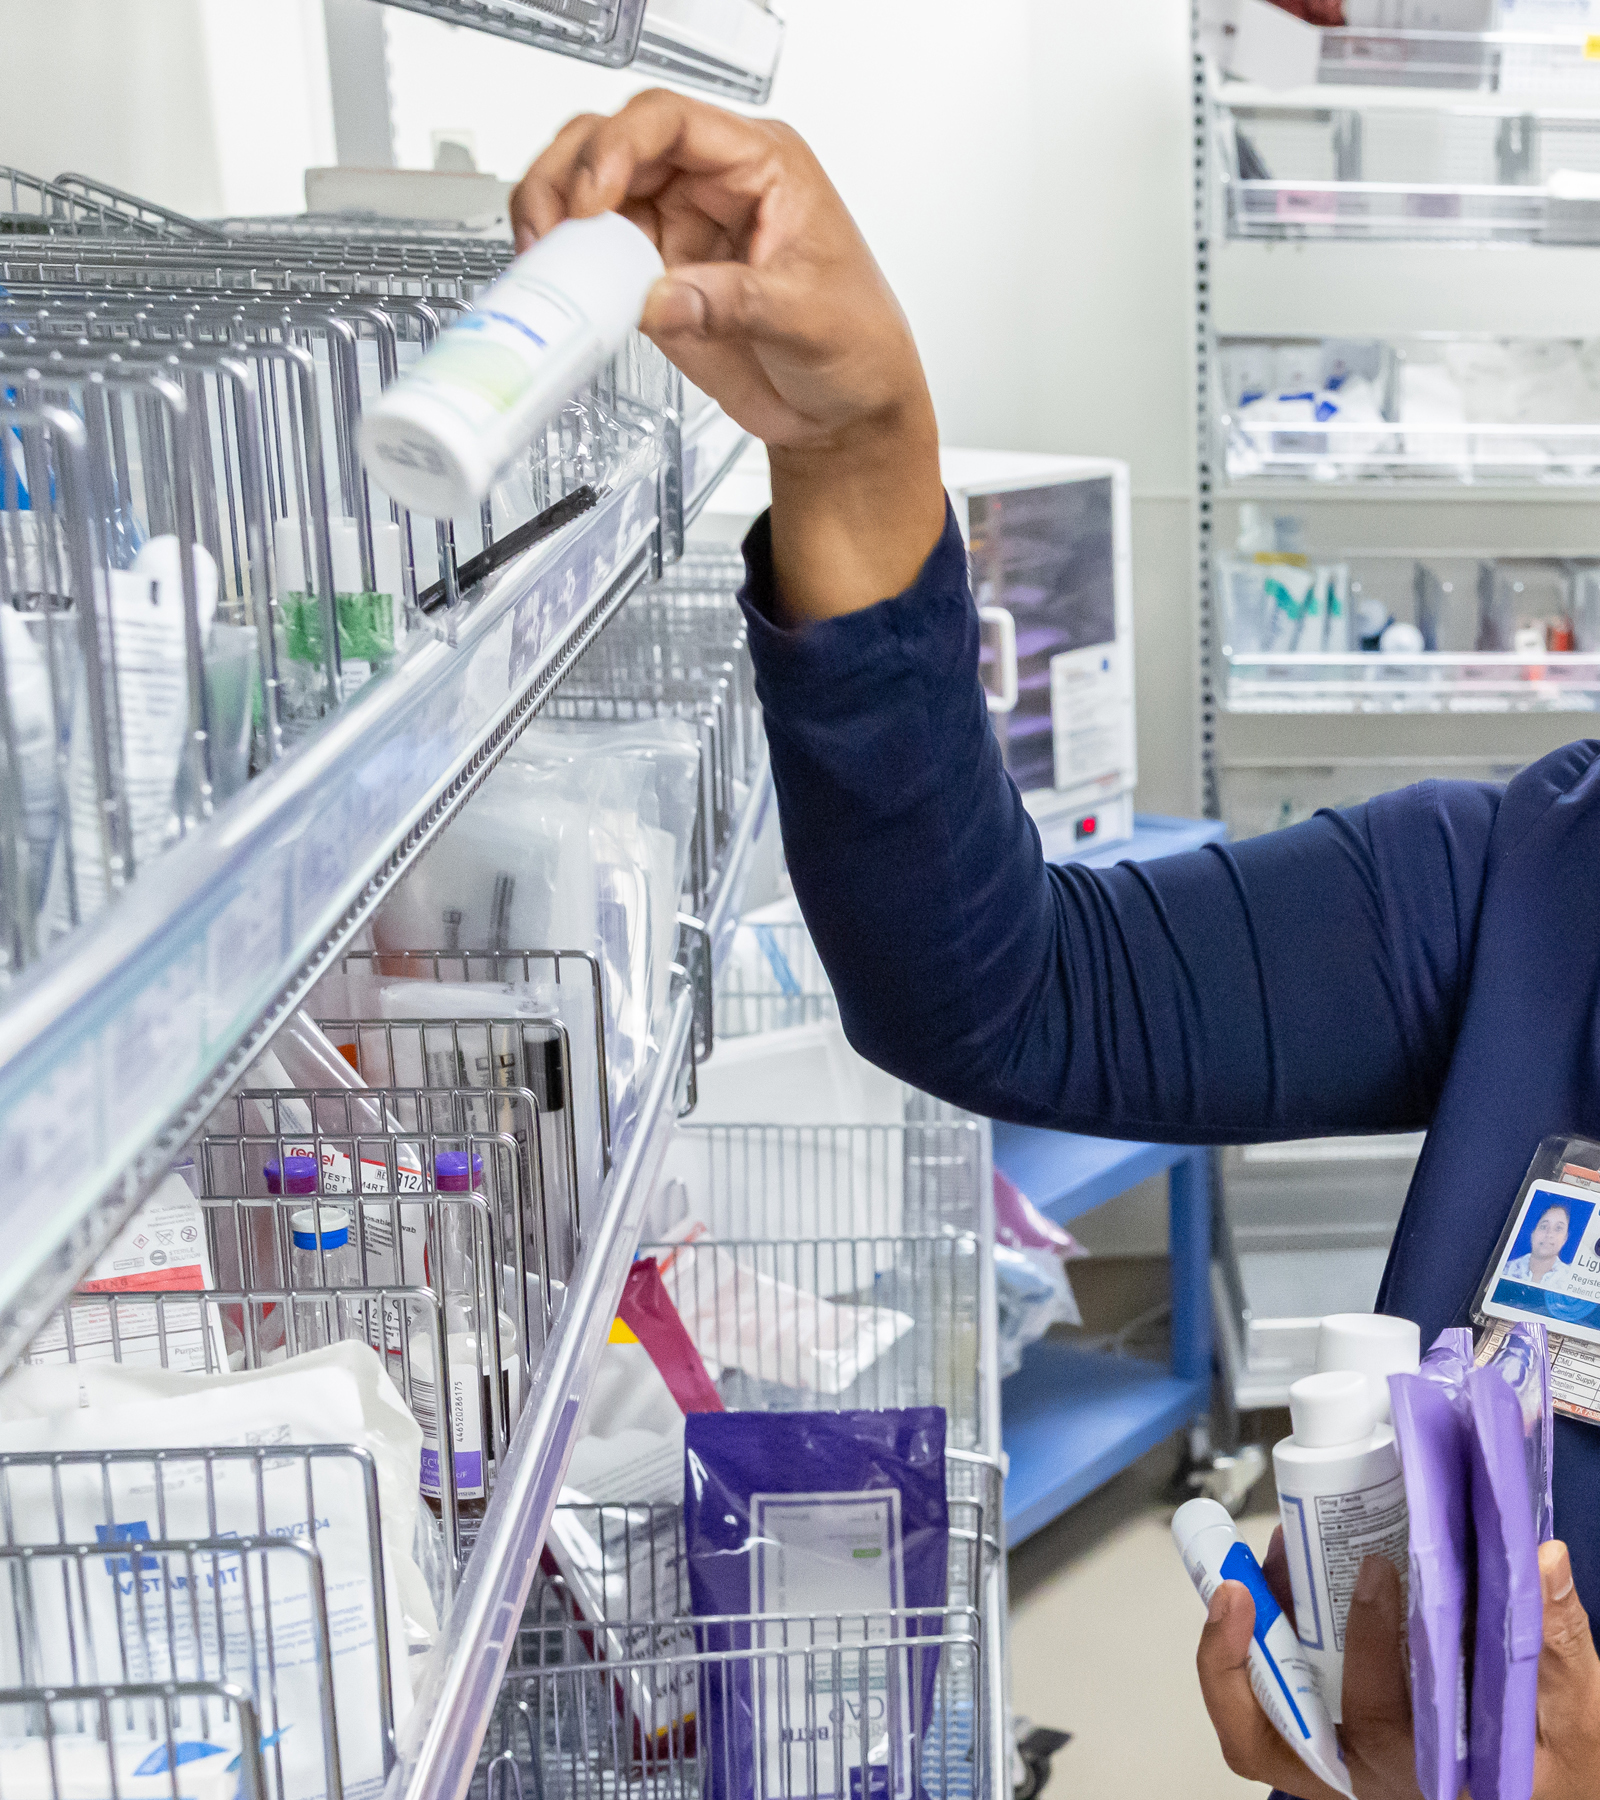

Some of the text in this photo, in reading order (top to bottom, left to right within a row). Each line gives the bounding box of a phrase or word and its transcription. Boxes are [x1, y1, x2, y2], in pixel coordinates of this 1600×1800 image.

[1567, 1285, 1593, 1298] Patient
[1557, 1357, 1572, 1366] CMU
[1580, 1353, 1595, 1362] Bank
[1552, 1367, 1574, 1378] Central
[1576, 1374, 1597, 1386] Supply
